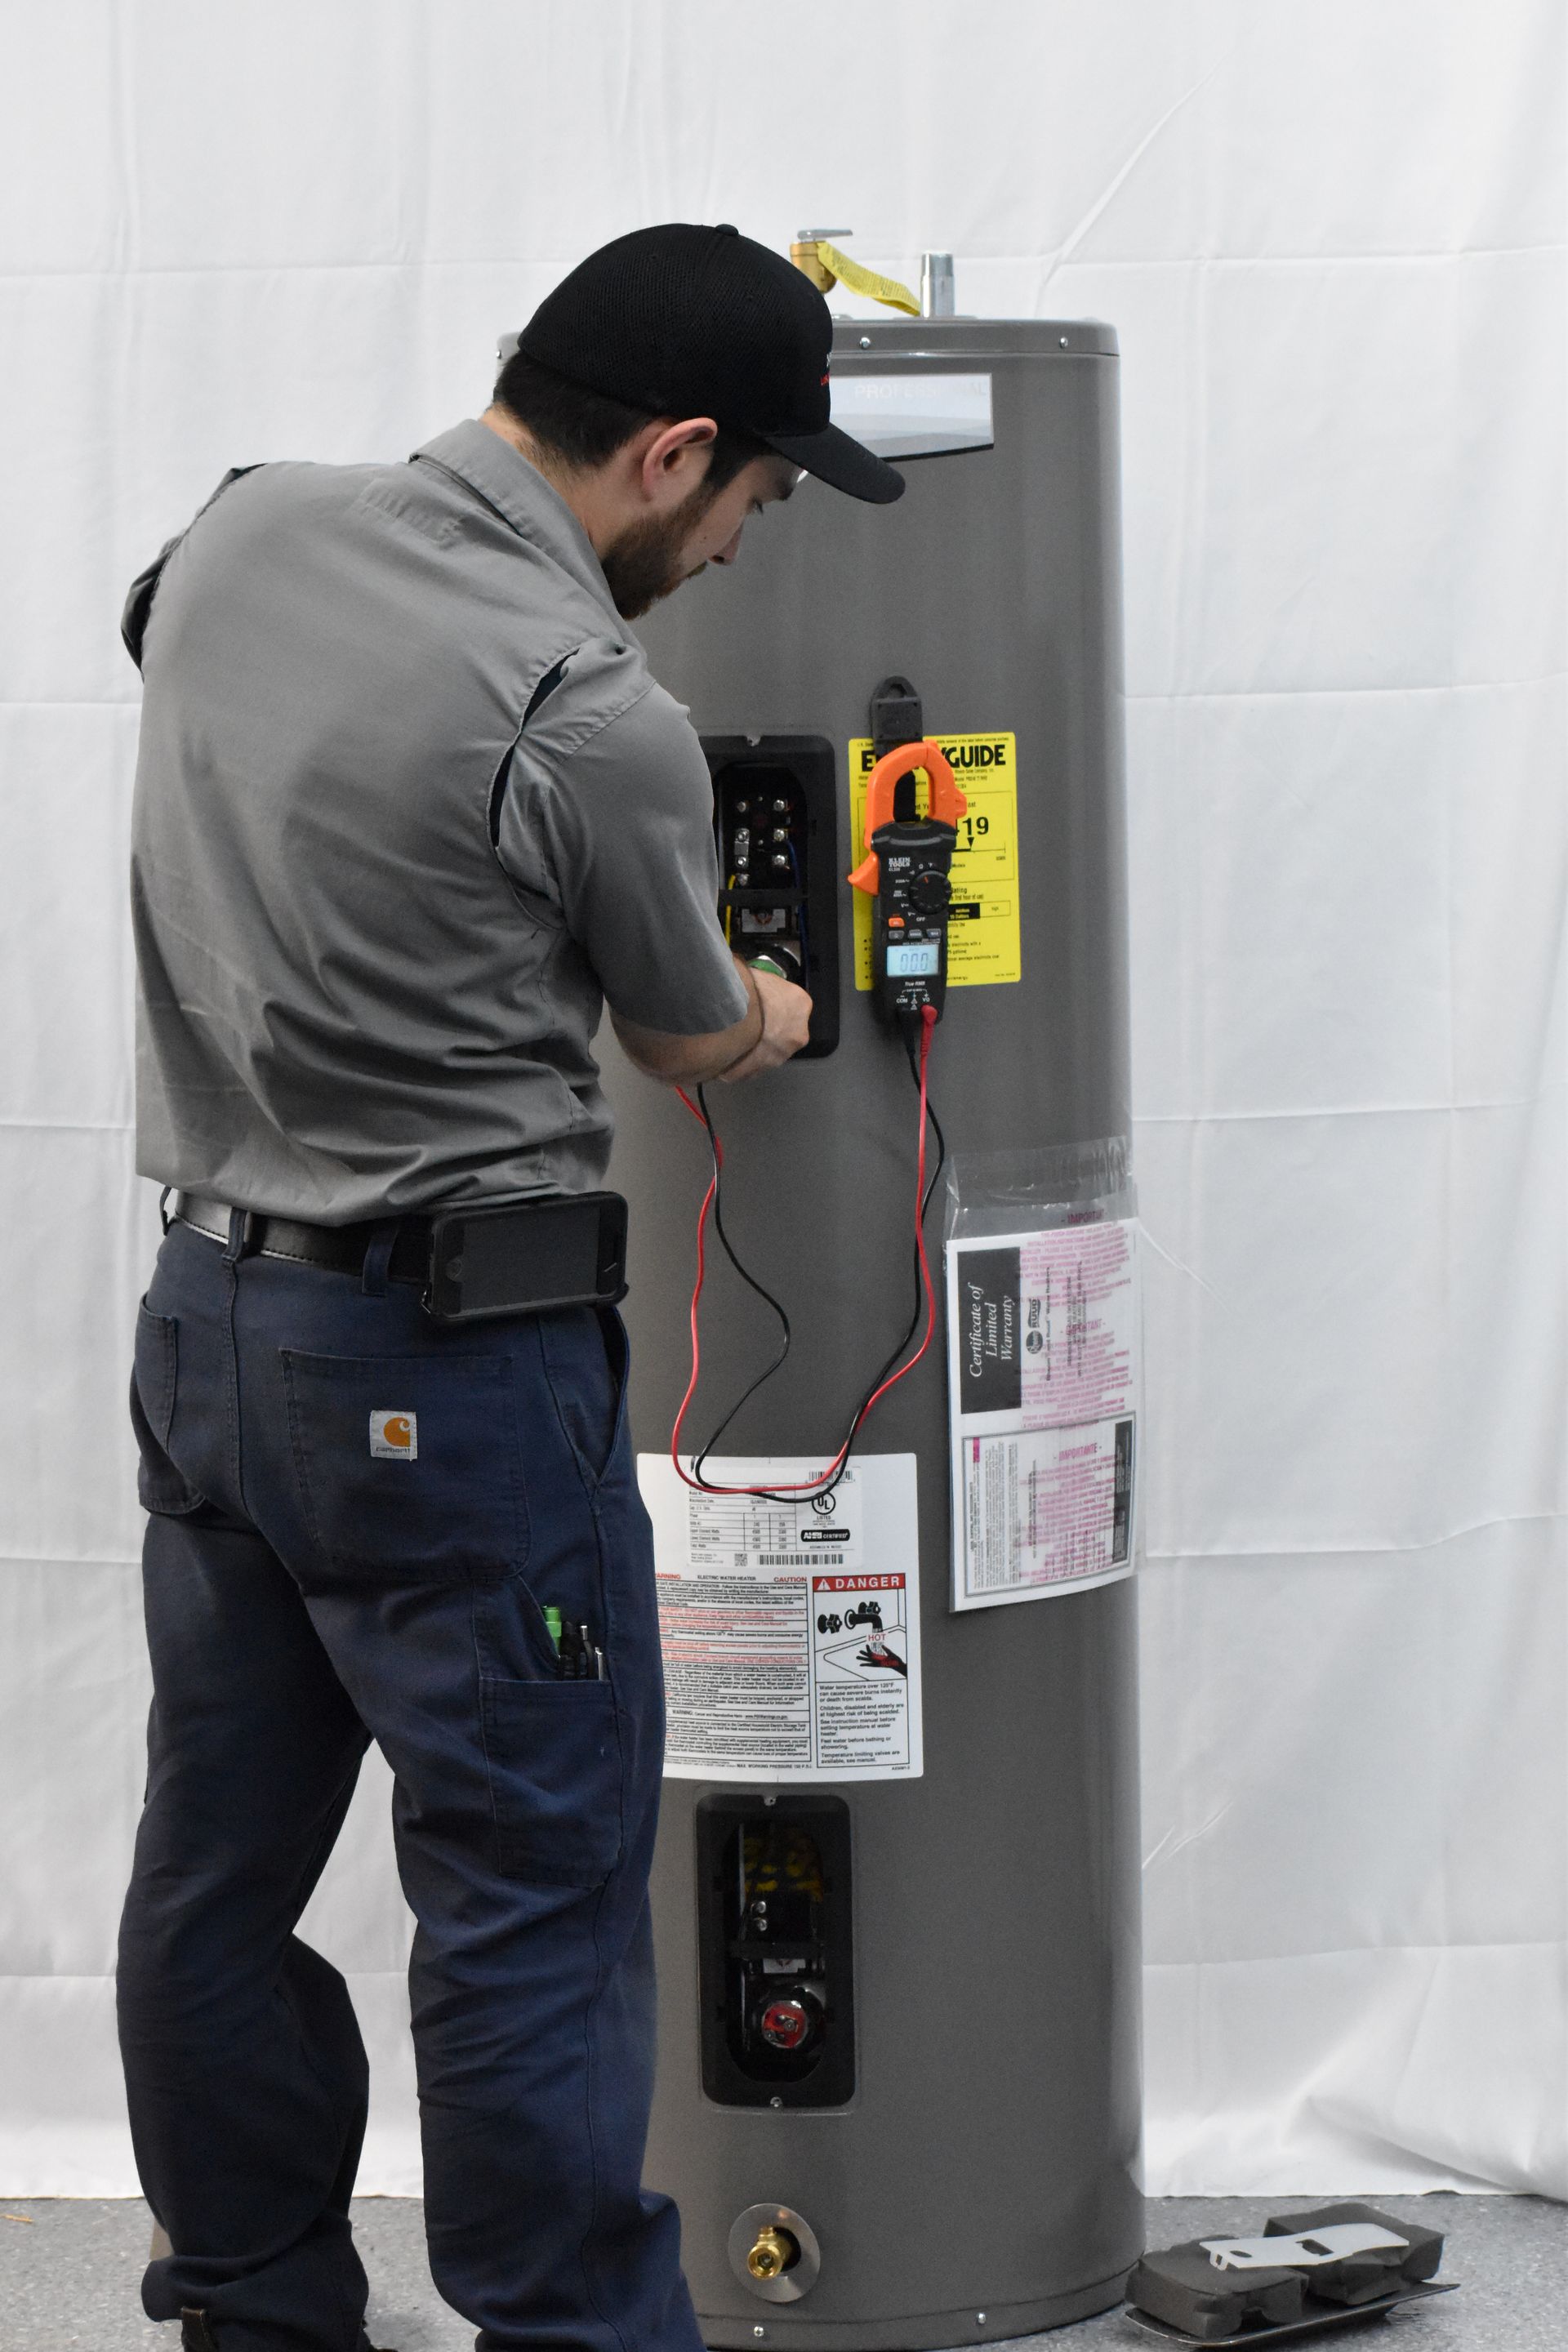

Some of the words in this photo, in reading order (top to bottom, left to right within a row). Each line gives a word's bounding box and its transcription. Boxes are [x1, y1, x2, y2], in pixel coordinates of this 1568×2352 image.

[968, 1282, 983, 1299] of
[969, 1303, 984, 1377] Certificate
[985, 1303, 998, 1356] Limited
[1000, 1295, 1015, 1360] Warranty
[1059, 1443, 1098, 1461] IMPORTANTE
[835, 1576, 899, 1588] DANGER
